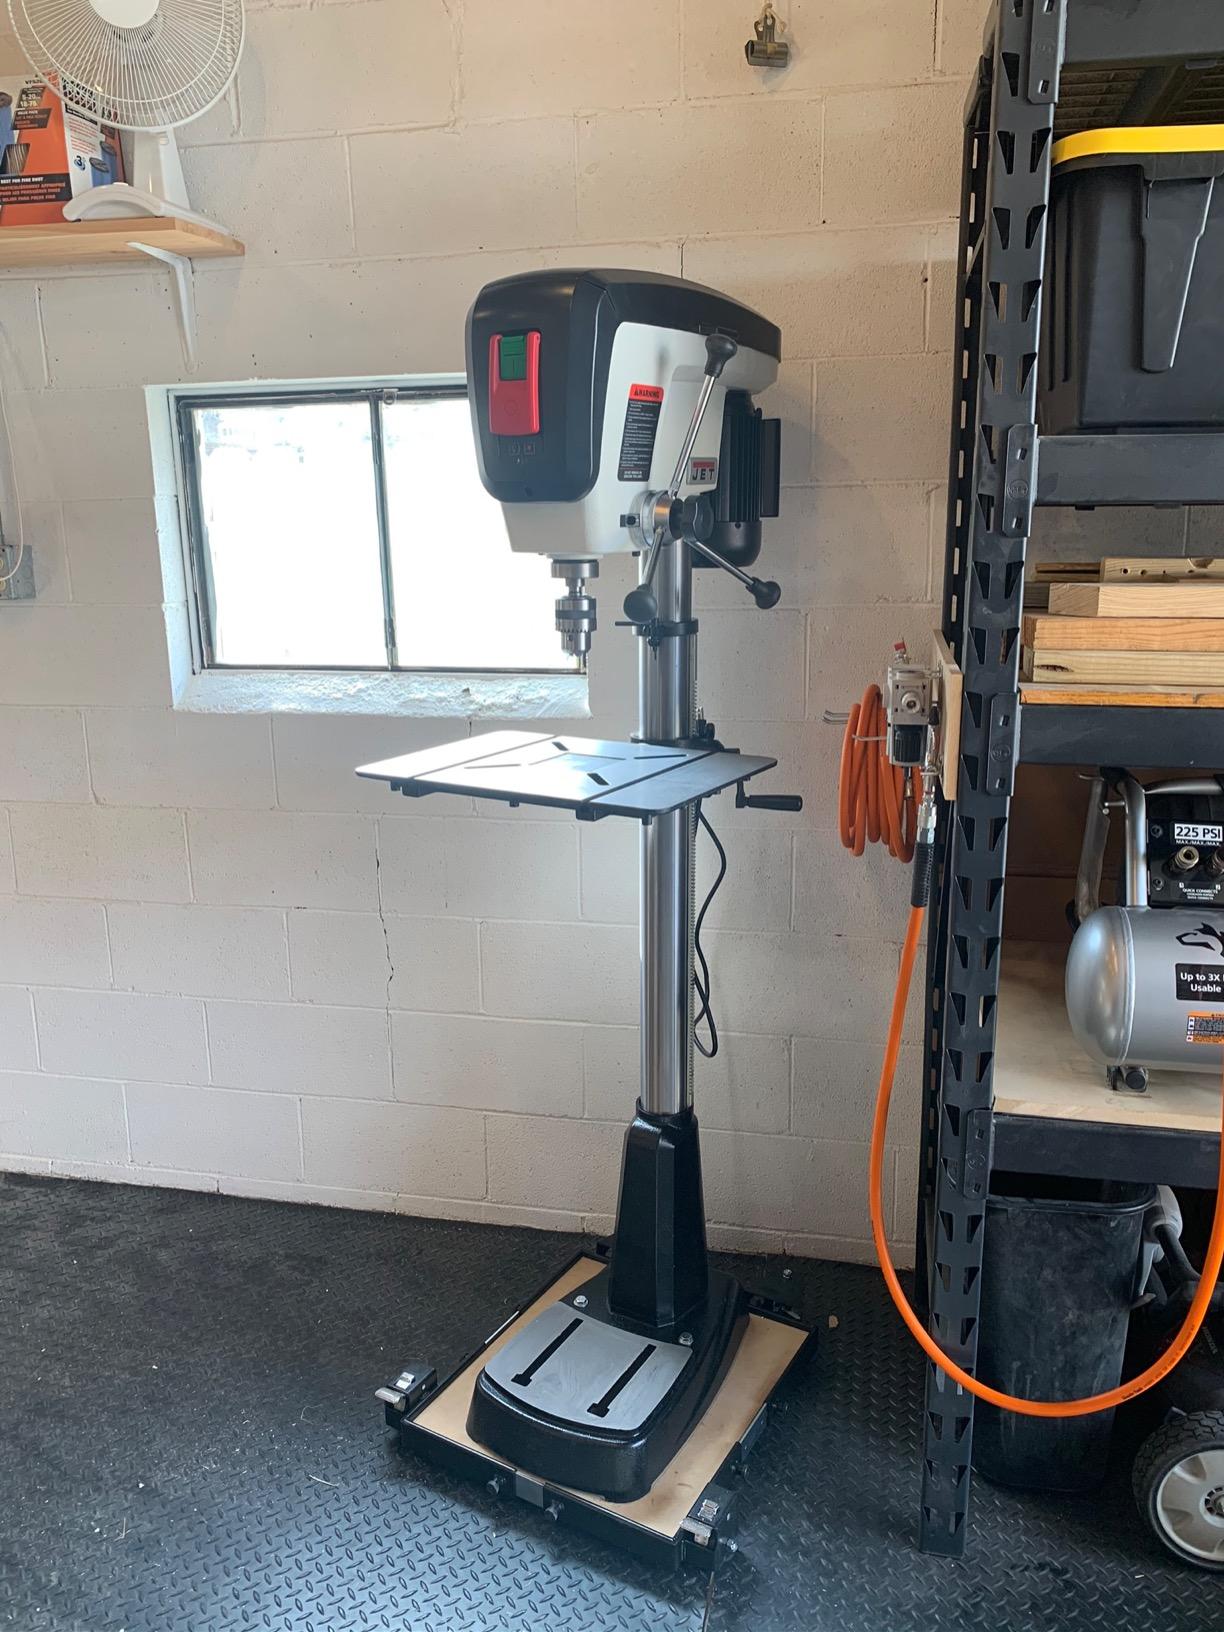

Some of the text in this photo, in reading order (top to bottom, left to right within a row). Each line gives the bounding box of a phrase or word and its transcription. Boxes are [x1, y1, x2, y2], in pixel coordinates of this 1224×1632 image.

[692, 468, 715, 480] JET
[1176, 826, 1221, 839] 225 PSI
[1180, 972, 1194, 982] Up
[1208, 973, 1221, 981] 3X
[1190, 983, 1222, 992] Usable
